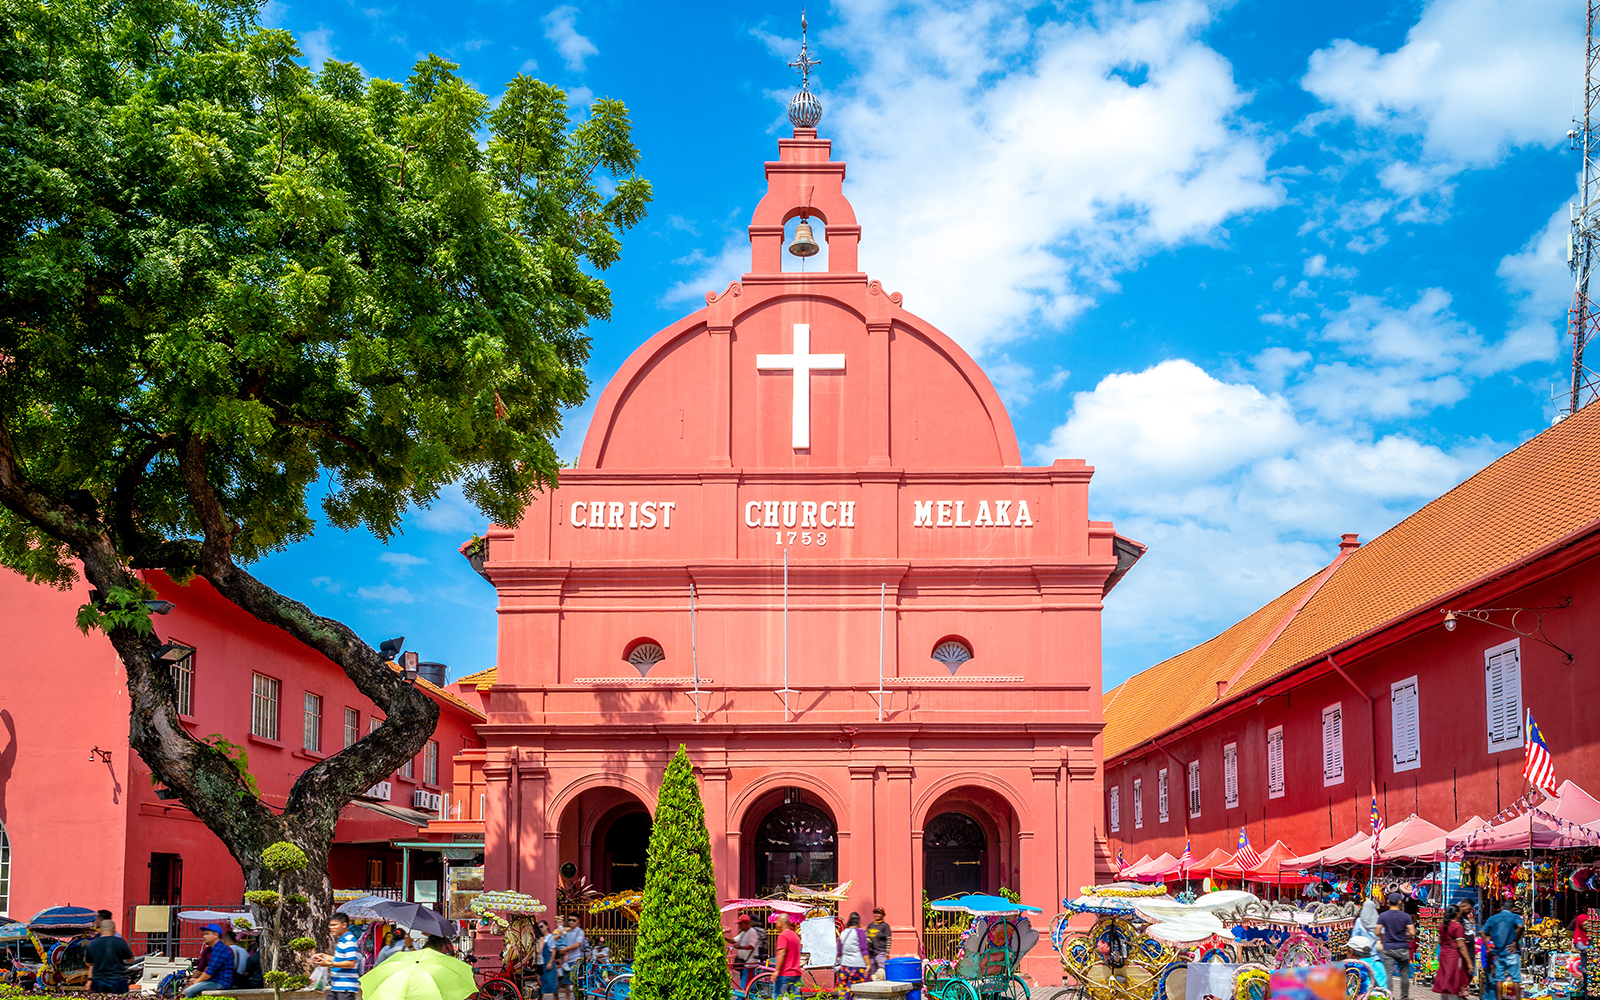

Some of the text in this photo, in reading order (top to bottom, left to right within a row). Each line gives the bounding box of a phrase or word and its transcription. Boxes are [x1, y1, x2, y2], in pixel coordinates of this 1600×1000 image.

[570, 499, 1034, 529] CHRIST CHURCH MELAKA
[775, 531, 828, 547] 1753
